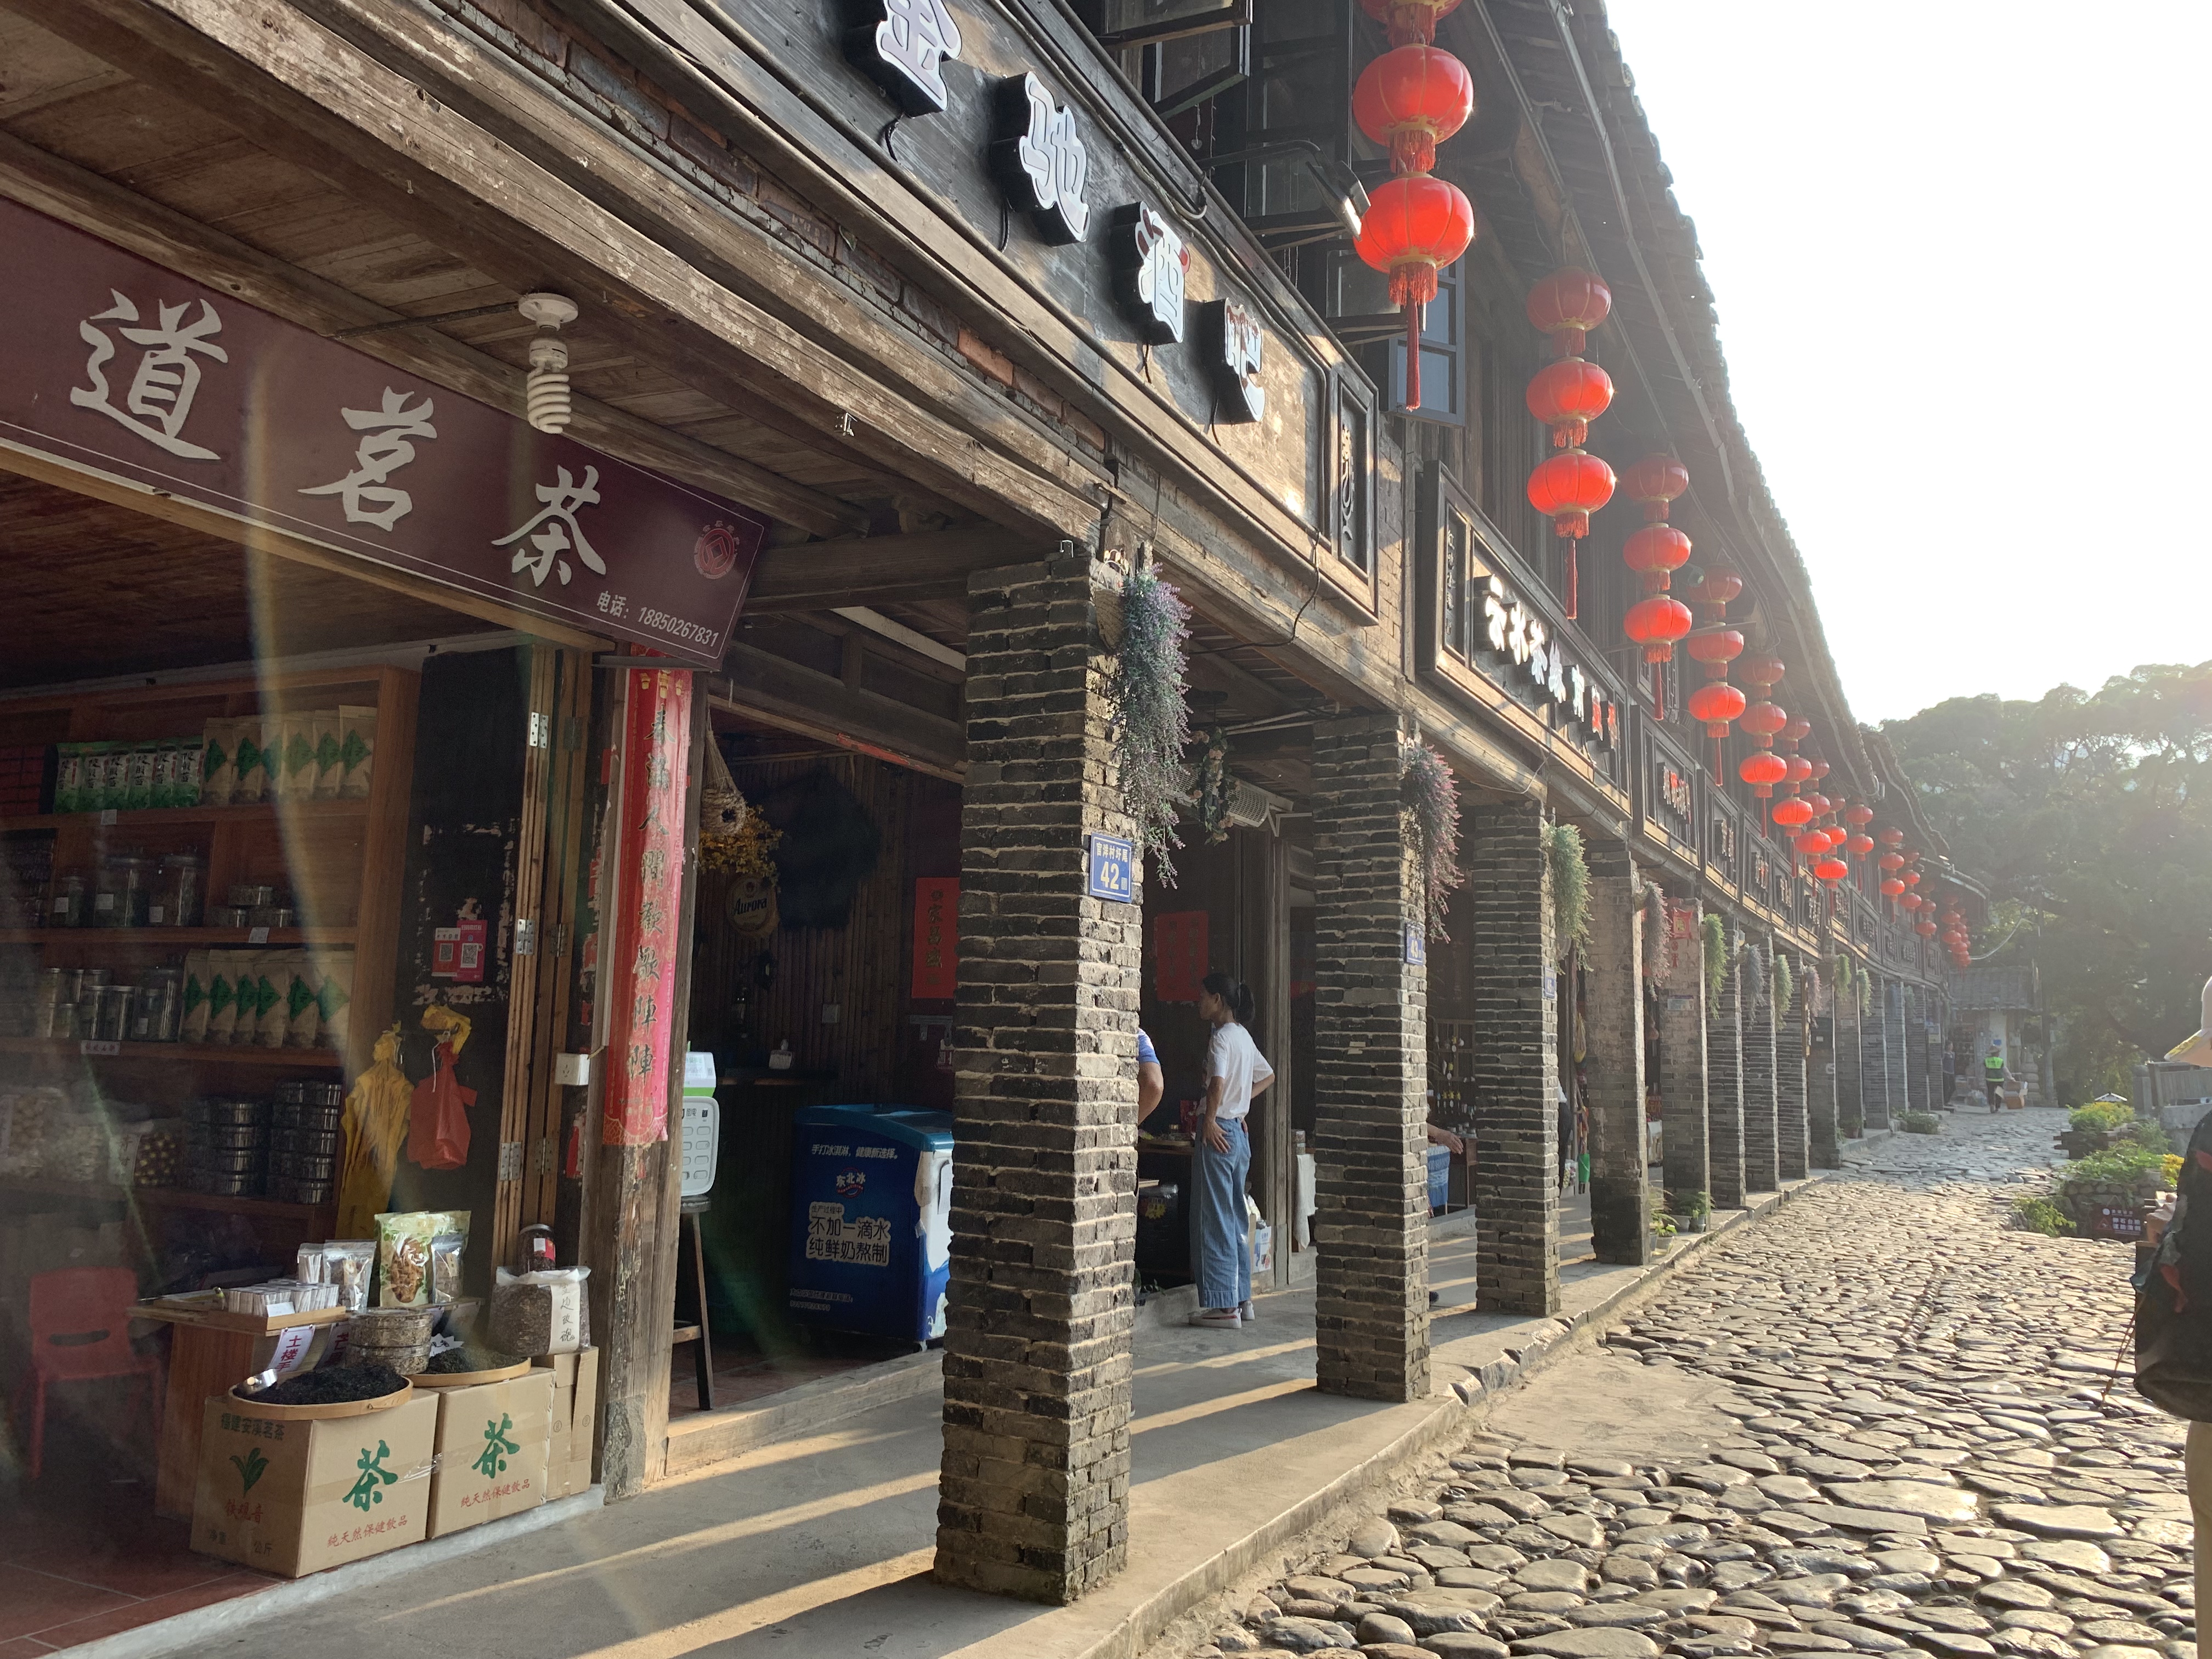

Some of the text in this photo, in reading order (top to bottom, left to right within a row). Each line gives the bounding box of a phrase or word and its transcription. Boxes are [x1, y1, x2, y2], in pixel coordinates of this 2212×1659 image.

[70, 289, 606, 587] 道茗茶
[1101, 861, 1120, 890] 42
[732, 898, 767, 916] Aurora
[810, 1216, 889, 1240] 不加一滴水
[809, 1237, 888, 1263] 纯鲜奶熬制
[221, 1412, 285, 1441] 福建安溪茗茶
[471, 1413, 520, 1479] 茶
[343, 1440, 398, 1512] 茶
[253, 1541, 273, 1556] 公斤
